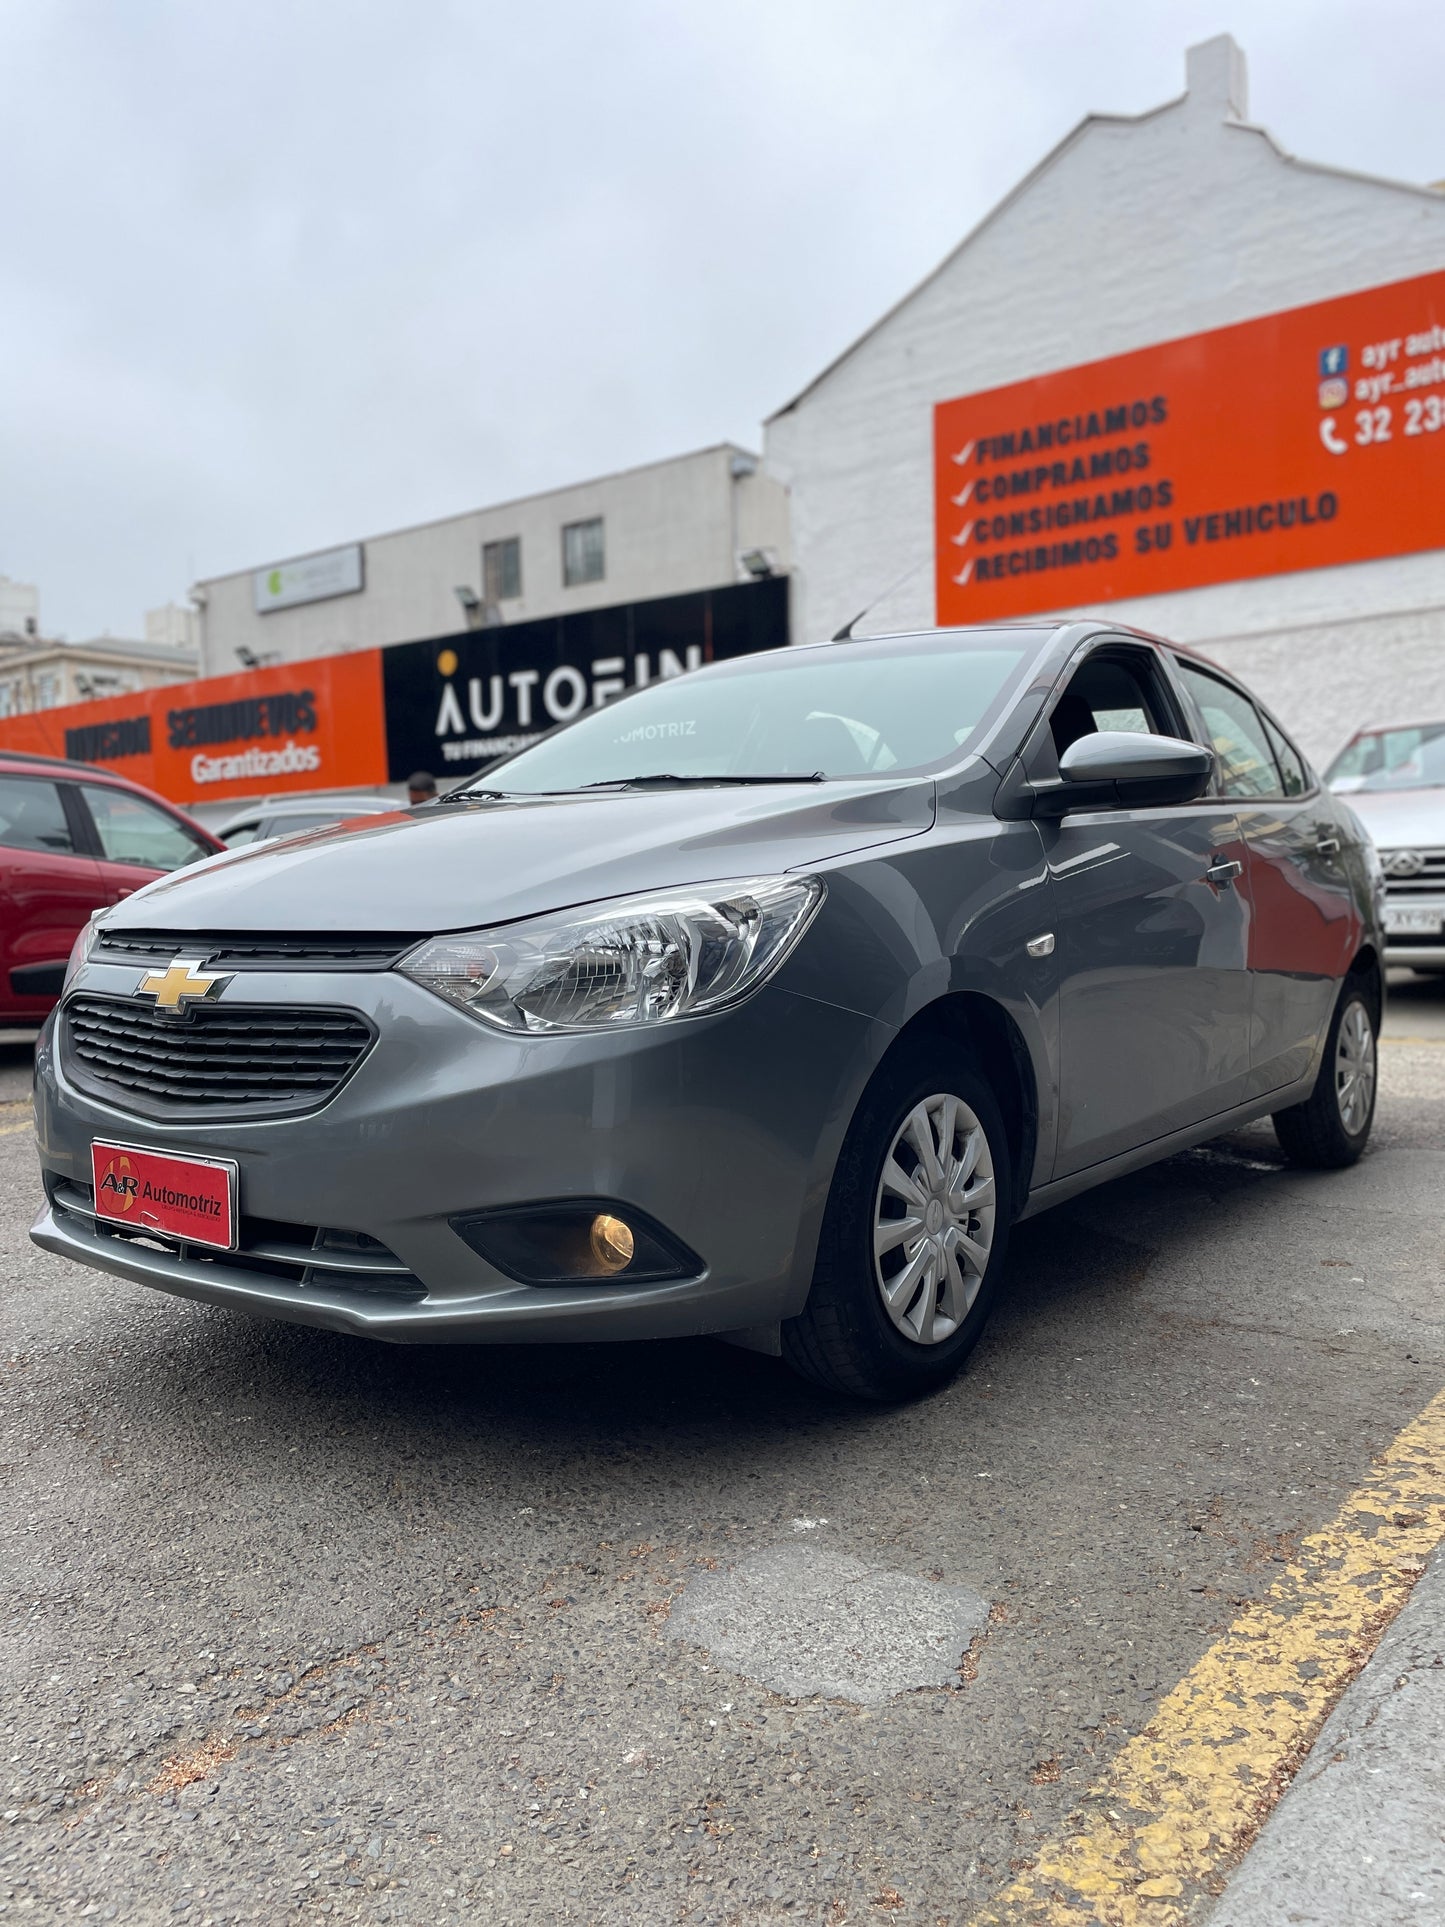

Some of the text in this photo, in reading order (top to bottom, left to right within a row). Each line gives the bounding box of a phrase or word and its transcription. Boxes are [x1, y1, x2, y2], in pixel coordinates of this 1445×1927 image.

[1361, 324, 1445, 371] ayr aut
[1354, 357, 1445, 404] ayr_aut
[976, 396, 1167, 465] FINANCIAMOS
[1355, 394, 1445, 446] 32 23
[974, 441, 1149, 504] COMPRAMOS
[974, 480, 1173, 543] CONSIGNAMOS
[975, 492, 1338, 582] RECIBIMOS SU VEHICULO
[190, 739, 322, 785] Garantizados
[142, 1181, 222, 1217] Automotriz
